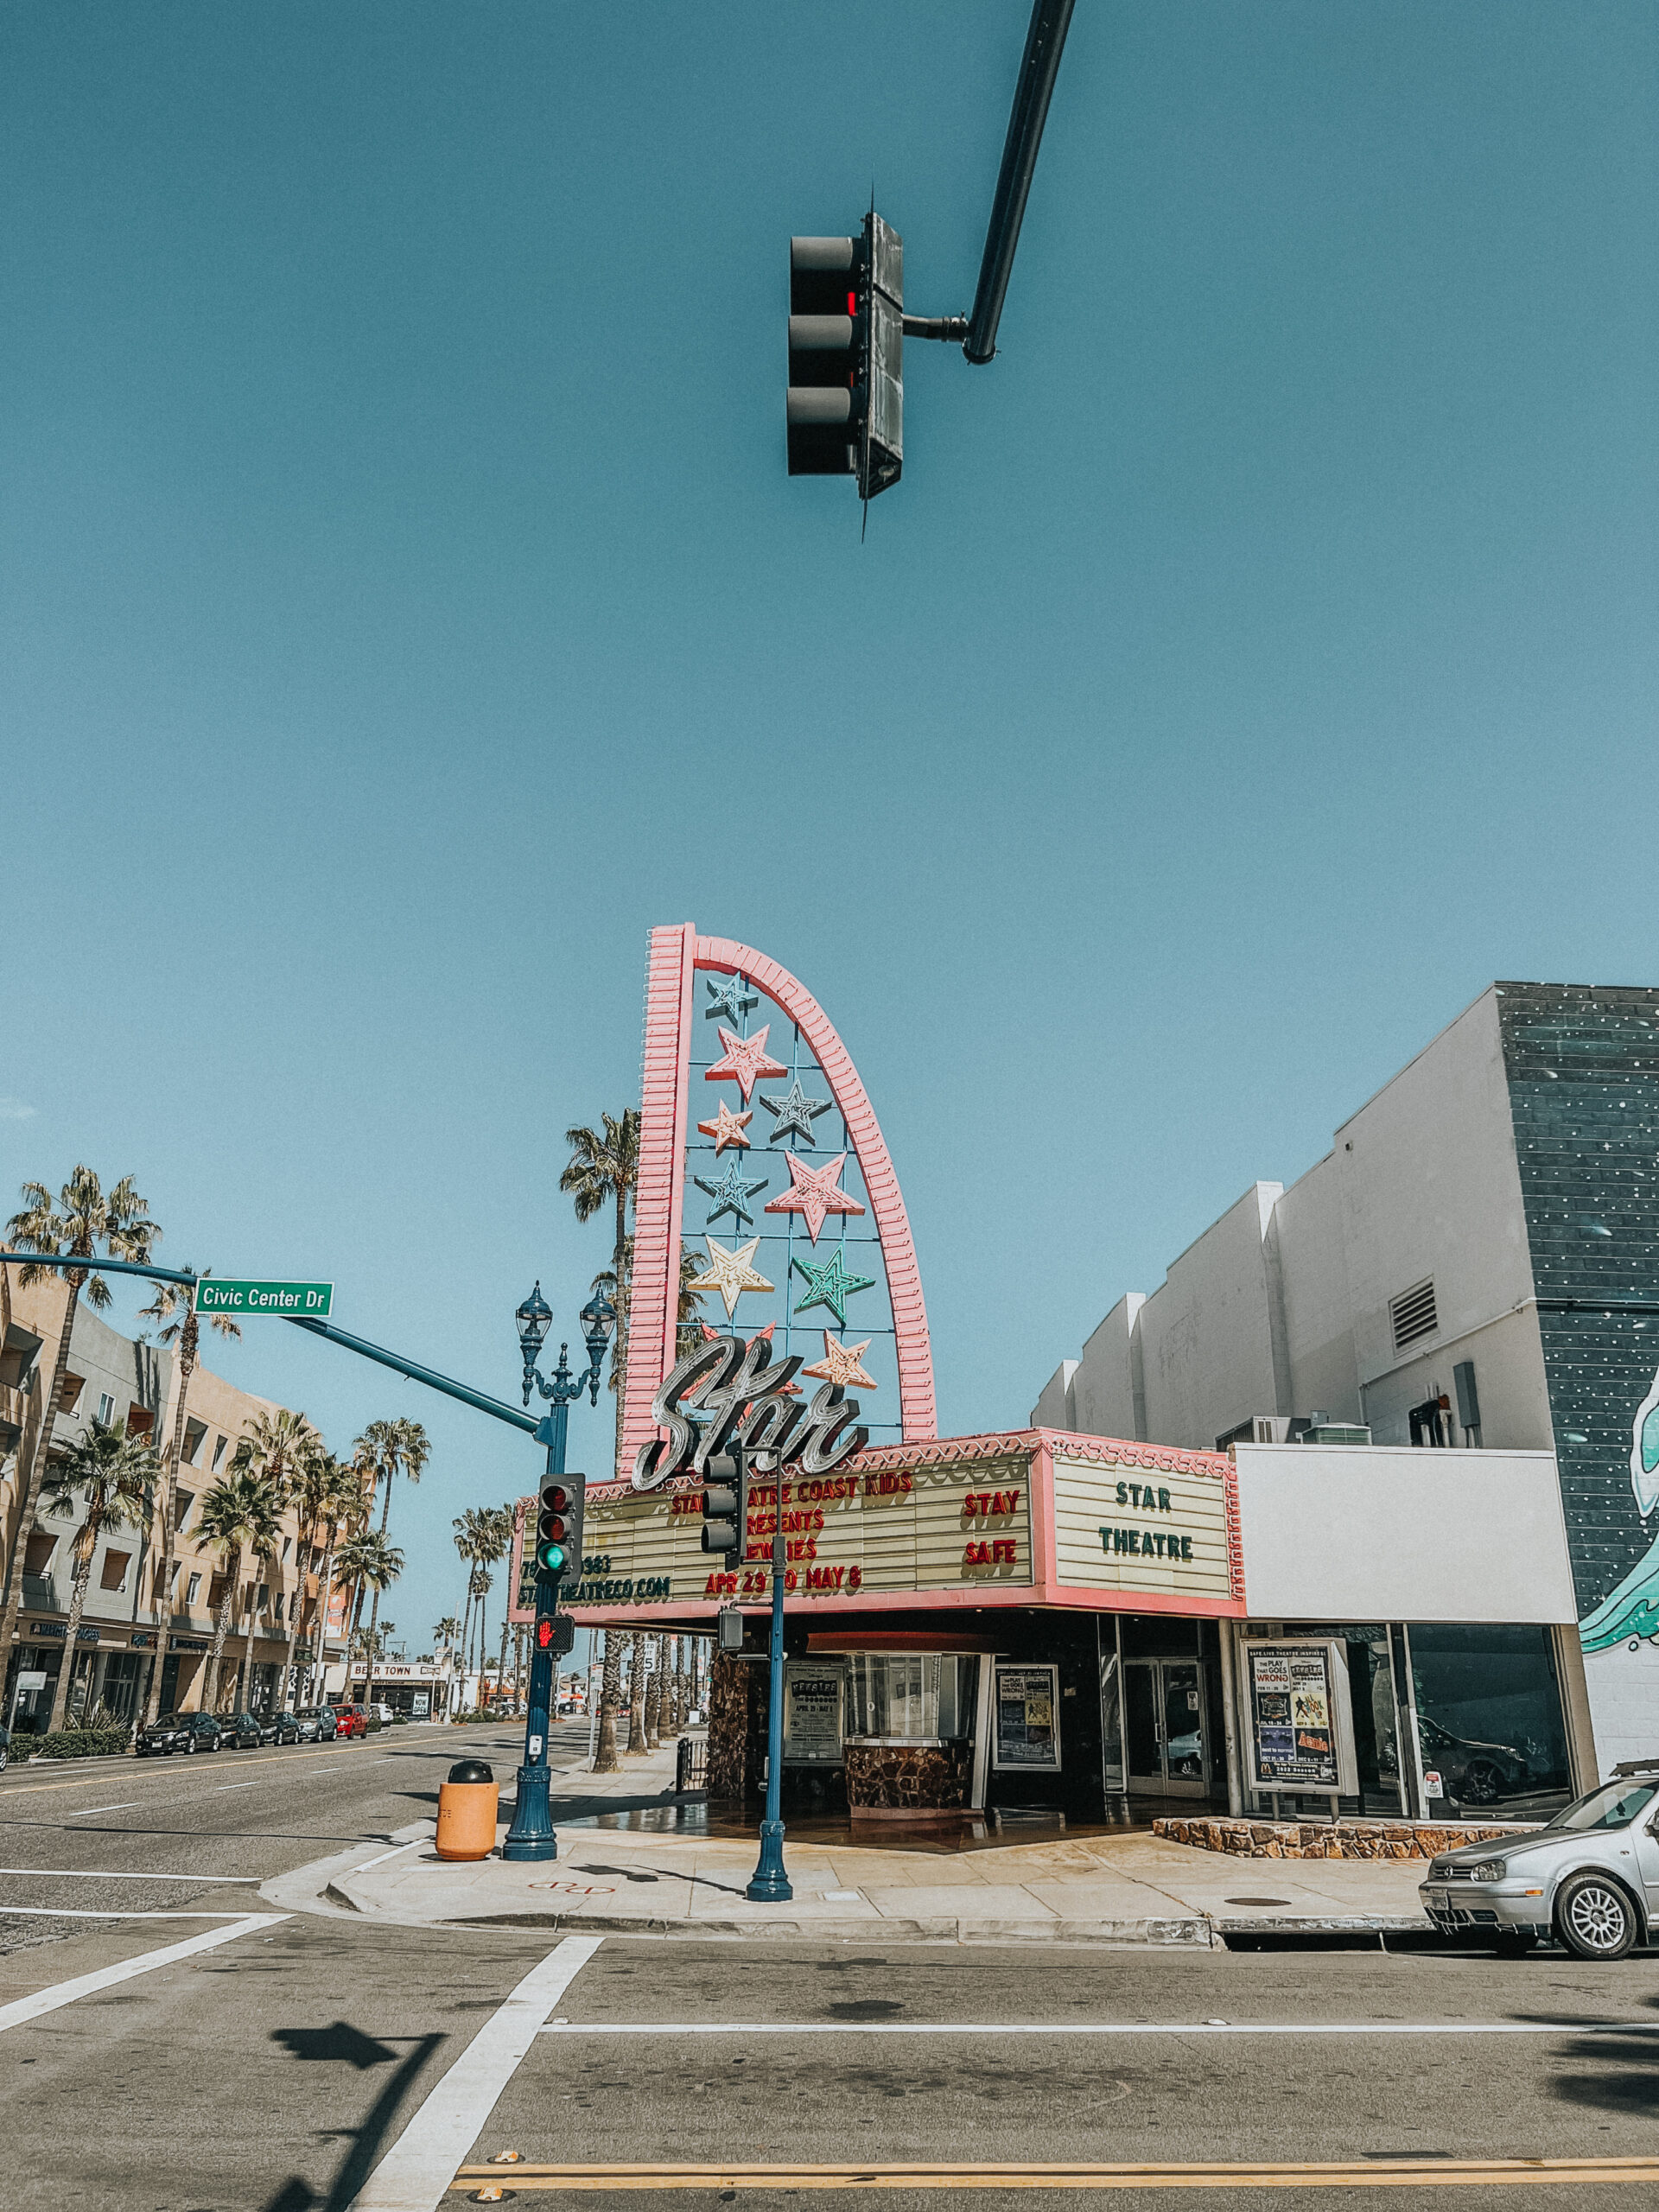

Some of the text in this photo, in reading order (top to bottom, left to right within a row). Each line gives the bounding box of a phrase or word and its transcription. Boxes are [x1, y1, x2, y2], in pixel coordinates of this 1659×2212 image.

[203, 1287, 324, 1308] Civic Center Dr
[632, 1335, 868, 1491] Star
[798, 1476, 859, 1502] COAST
[865, 1471, 912, 1497] KIDS
[1116, 1481, 1172, 1511] STAR
[964, 1490, 1020, 1517] STAY
[747, 1508, 824, 1536] RESENTS
[965, 1539, 1017, 1565] SAFE
[1099, 1527, 1194, 1560] THEATRE
[705, 1573, 738, 1594] APR
[743, 1571, 766, 1592] 29
[806, 1567, 845, 1589] MAY
[849, 1565, 861, 1588] 8
[385, 1666, 411, 1675] TOWN
